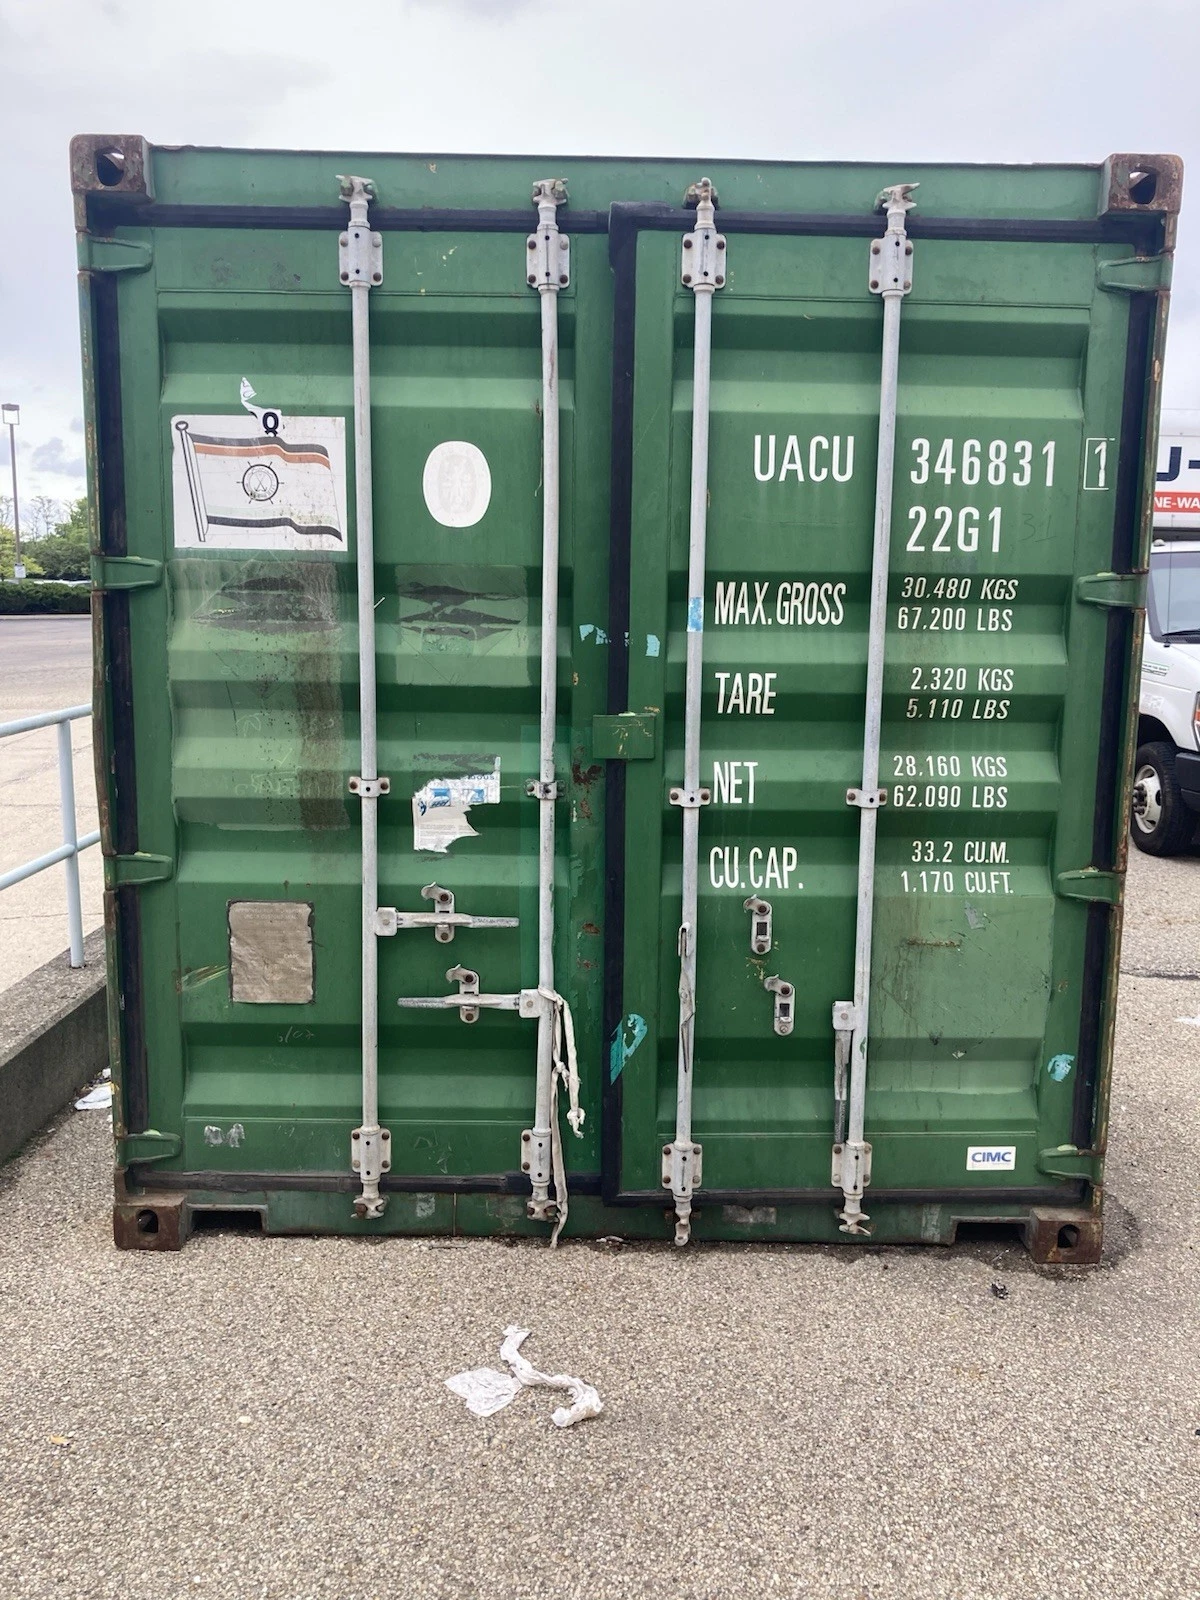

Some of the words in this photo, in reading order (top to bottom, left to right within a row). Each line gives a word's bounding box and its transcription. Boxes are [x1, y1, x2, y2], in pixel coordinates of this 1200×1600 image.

[753, 434, 855, 483] UACU
[910, 437, 1056, 487] 346831
[906, 505, 1003, 553] 22G1
[979, 578, 1019, 600] KGS
[976, 607, 1013, 631] LBS
[714, 672, 778, 715] TARE
[977, 668, 1015, 692] KGS
[971, 698, 1011, 720] LBS
[713, 761, 759, 805] NET
[971, 755, 1008, 778] KGS
[971, 785, 1008, 809] LBS
[911, 841, 954, 863] 33.2
[963, 841, 1010, 864] CU.M.
[964, 872, 1014, 895] CU.FT.
[971, 1151, 1012, 1162] CIMC
